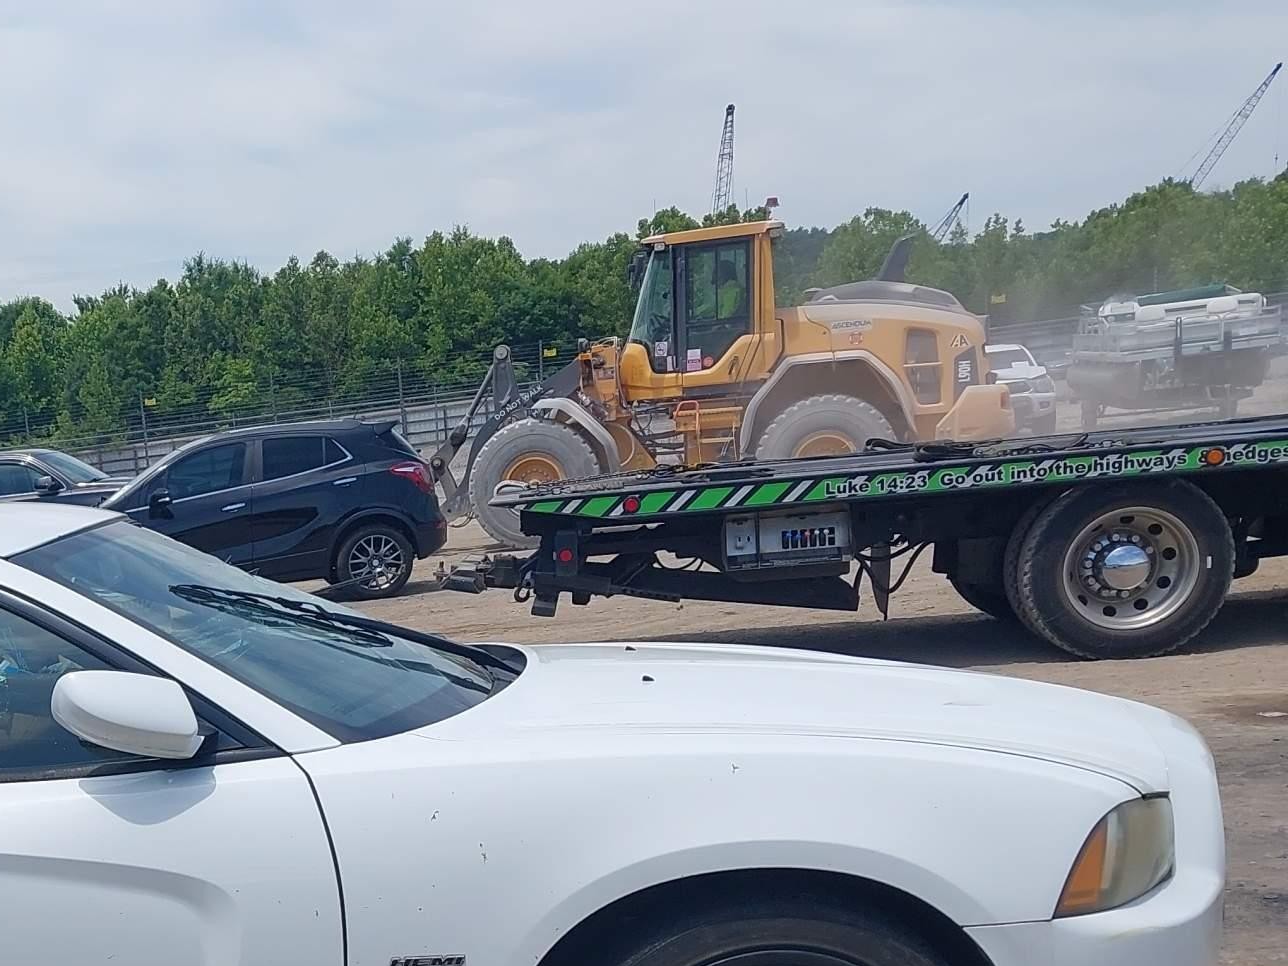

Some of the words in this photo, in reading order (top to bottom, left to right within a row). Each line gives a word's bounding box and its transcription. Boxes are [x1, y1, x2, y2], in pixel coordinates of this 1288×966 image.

[958, 360, 971, 383] L90H
[494, 409, 506, 421] DO
[506, 398, 522, 413] NOT
[521, 384, 544, 402] WALK
[824, 477, 870, 498] Luke
[876, 473, 928, 493] 14:23
[940, 471, 966, 488] Go
[972, 468, 1004, 484] out
[1010, 464, 1048, 482] into
[1054, 459, 1088, 477] the
[1092, 451, 1188, 476] highways
